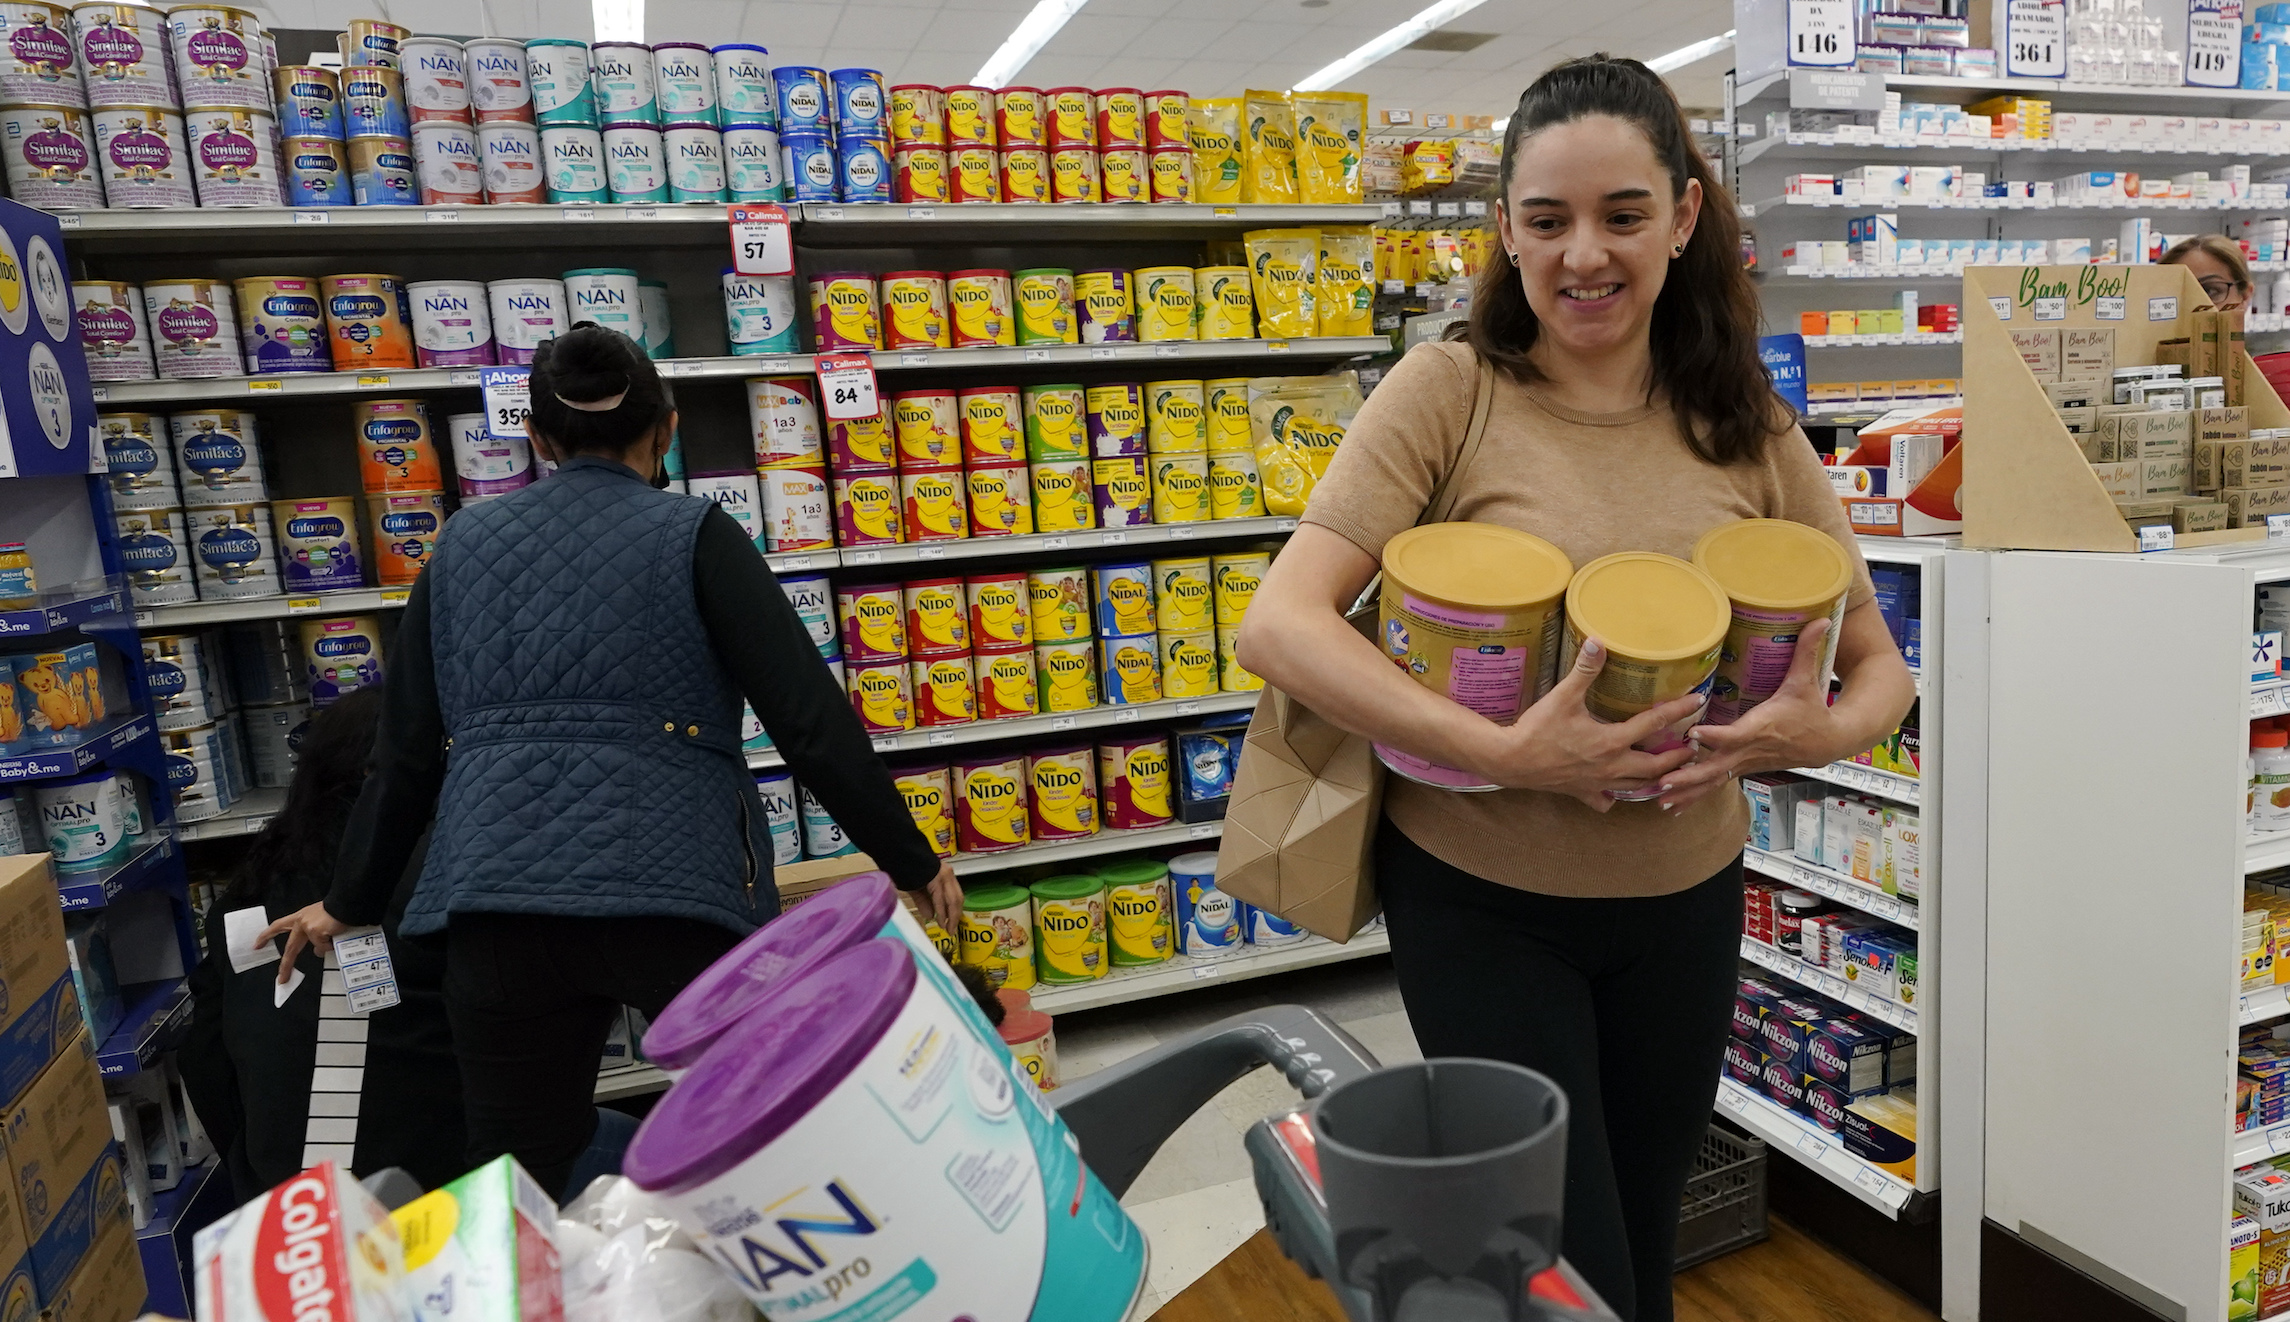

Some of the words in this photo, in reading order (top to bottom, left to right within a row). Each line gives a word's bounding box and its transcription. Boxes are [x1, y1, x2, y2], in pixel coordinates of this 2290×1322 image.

[1810, 7, 1823, 15] DX
[86, 38, 135, 53] Similac
[192, 41, 242, 57] Similac
[1797, 33, 1837, 53] 146
[200, 52, 217, 61] Total
[2015, 43, 2052, 63] 364
[2194, 52, 2225, 71] 119
[1810, 74, 1867, 85] MEDICAMENTOS
[1818, 87, 1828, 97] DE
[1830, 86, 1860, 97] PATENTE
[29, 141, 82, 157] Similac
[113, 141, 165, 156] Similac
[203, 141, 251, 156] Similac
[490, 141, 531, 154] NAN
[554, 145, 593, 158] NAN
[612, 145, 648, 158] NAN
[681, 145, 717, 158] NAN
[731, 145, 766, 158] NAN
[38, 155, 55, 163] Total
[120, 155, 138, 163] Total
[210, 155, 226, 163] Total
[809, 165, 832, 174] NIDAL
[851, 166, 877, 175] NIDAL
[593, 177, 597, 186] 1
[648, 177, 654, 187] 2
[716, 177, 722, 187] 2
[747, 211, 783, 220] Calimax
[745, 242, 764, 259] 57
[727, 284, 765, 300] NAN
[2019, 266, 2071, 307] Bam
[2078, 265, 2131, 305] Boo!
[578, 290, 624, 304] NAN
[267, 301, 318, 313] Enfagrow
[332, 301, 381, 313] Enfagrow
[424, 297, 467, 310] NAN
[509, 297, 549, 310] NAN
[162, 315, 211, 327] Similac
[763, 316, 771, 330] 3
[467, 331, 474, 343] 1
[305, 347, 312, 357] 2
[365, 344, 373, 354] 3
[833, 359, 867, 369] Calimax
[780, 396, 806, 406] Baby
[835, 388, 858, 404] 84
[1039, 404, 1073, 415] NIDO
[1106, 410, 1139, 421] NIDO
[1167, 408, 1200, 419] NIDO
[52, 409, 61, 436] 3
[507, 461, 512, 472] 1
[1037, 478, 1072, 489] NIDO
[1168, 479, 1201, 489] NIDO
[1211, 475, 1243, 486] NIDO
[972, 482, 1003, 493] NIDO
[1112, 481, 1145, 493] NIDO
[290, 522, 340, 534] Enfagrow
[385, 516, 431, 528] Enfagrow
[747, 527, 753, 537] 2
[325, 566, 334, 576] 2
[1175, 585, 1207, 598] NIDO
[1225, 580, 1259, 592] NIDO
[1029, 589, 1058, 600] NIDO
[1110, 589, 1145, 599] NIDAL
[919, 599, 954, 610] NIDO
[981, 595, 1015, 607] NIDO
[859, 605, 894, 617] NIDO
[823, 622, 830, 634] 3
[318, 640, 366, 652] Enfagrow
[1117, 658, 1151, 669] NIDAL
[1180, 653, 1211, 665] NIDO
[1050, 659, 1085, 672] NIDO
[932, 672, 966, 683] NIDO
[993, 666, 1027, 678] NIDO
[861, 679, 897, 692] NIDO
[1131, 759, 1168, 776] NIDO
[1037, 771, 1081, 787] NIDO
[970, 782, 1015, 799] NIDO
[44, 802, 95, 821] NAN
[95, 832, 106, 847] 3
[793, 830, 799, 846] 3
[831, 826, 842, 842] 3
[1113, 901, 1157, 916] NIDO
[1201, 901, 1231, 914] NIDAL
[1044, 915, 1089, 932] NIDO
[365, 937, 374, 946] 47
[371, 961, 379, 971] 47
[377, 986, 385, 996] 47
[1760, 1020, 1800, 1052] Nikzon
[1807, 1038, 1847, 1072] Nikzon
[1853, 1043, 1882, 1057] Nikzon
[1724, 1046, 1760, 1076] Nikzon
[1763, 1067, 1802, 1099] Nikzon
